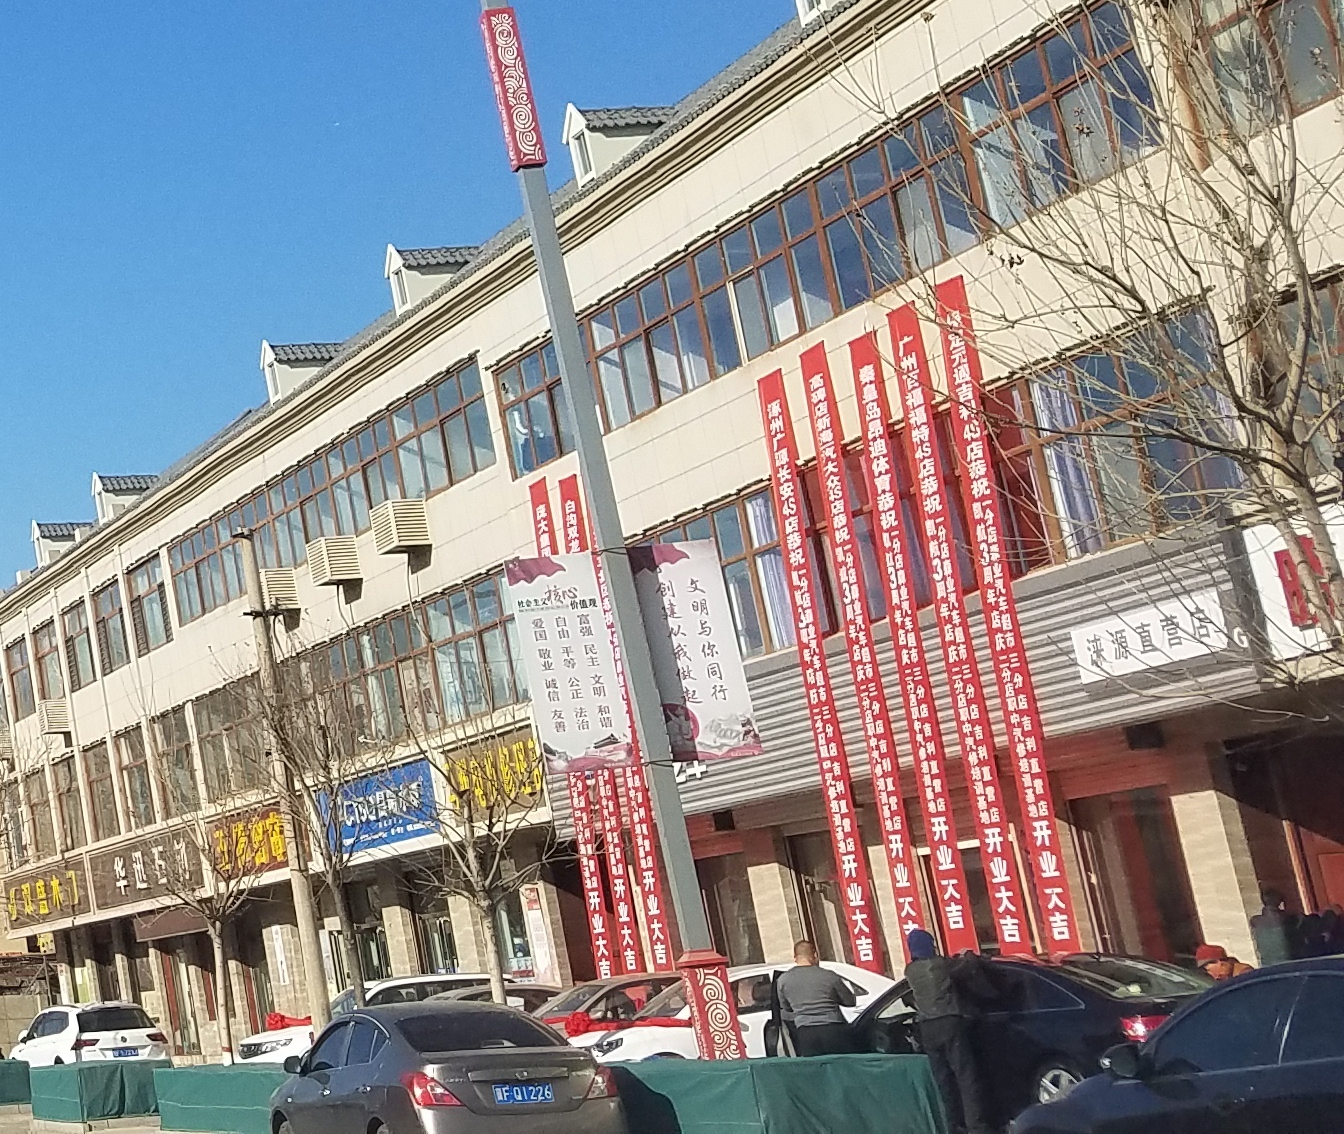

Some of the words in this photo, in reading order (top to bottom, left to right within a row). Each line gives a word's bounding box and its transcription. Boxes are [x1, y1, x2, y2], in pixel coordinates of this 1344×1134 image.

[532, 618, 547, 641] 爱国
[555, 616, 569, 639] 自由
[577, 613, 593, 637] 富强
[1087, 606, 1211, 666] 涞源直营店
[656, 581, 703, 704] 创建从我做起
[687, 578, 728, 701] 文明与你同行
[538, 649, 554, 672] 敬业
[561, 646, 576, 669] 平等
[584, 644, 600, 666] 民主
[544, 679, 560, 702] 诚信
[568, 677, 583, 700] 公正
[590, 674, 606, 697] 文明
[551, 709, 567, 732] 友善
[574, 707, 589, 730] 法治
[597, 704, 612, 728] 和谐
[930, 818, 965, 929] 开业大吉
[1032, 822, 1070, 940] 开业大吉
[984, 830, 1021, 942] 开业大吉
[642, 870, 667, 964] 开业大吉
[842, 855, 874, 961] 开业大吉
[587, 890, 612, 979] 开业大吉
[613, 880, 636, 971] 开业大吉
